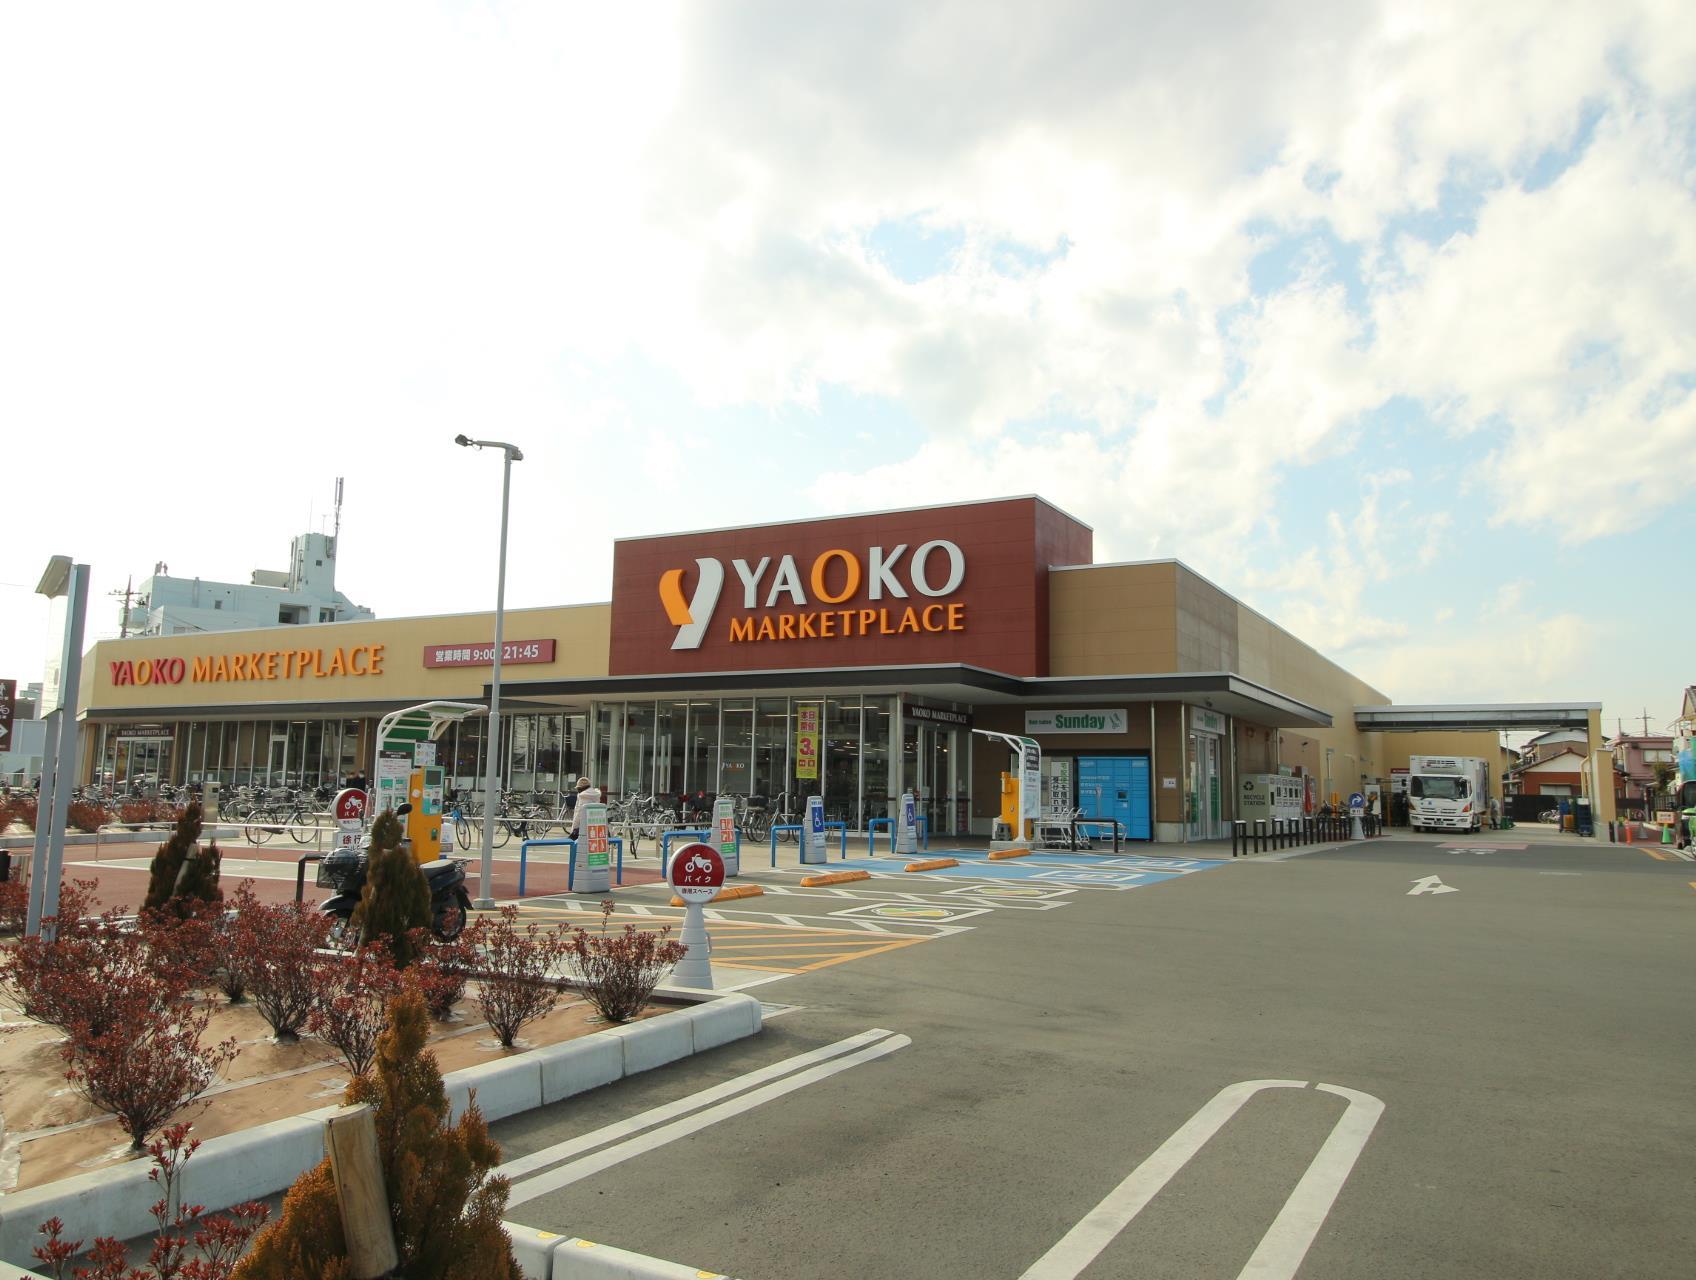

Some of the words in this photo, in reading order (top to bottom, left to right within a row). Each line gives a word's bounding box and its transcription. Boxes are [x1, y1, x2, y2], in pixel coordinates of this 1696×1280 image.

[731, 539, 966, 609] YAOKO
[728, 603, 966, 642] MARKETPLACE
[435, 649, 471, 662] 営業時間
[110, 657, 187, 686] YAOKO
[191, 644, 385, 683] MARKETPLACE
[912, 706, 931, 719] YAOKO
[931, 710, 967, 724] MARKETPLACE
[1055, 714, 1106, 729] Sunday
[684, 875, 711, 883] バイク
